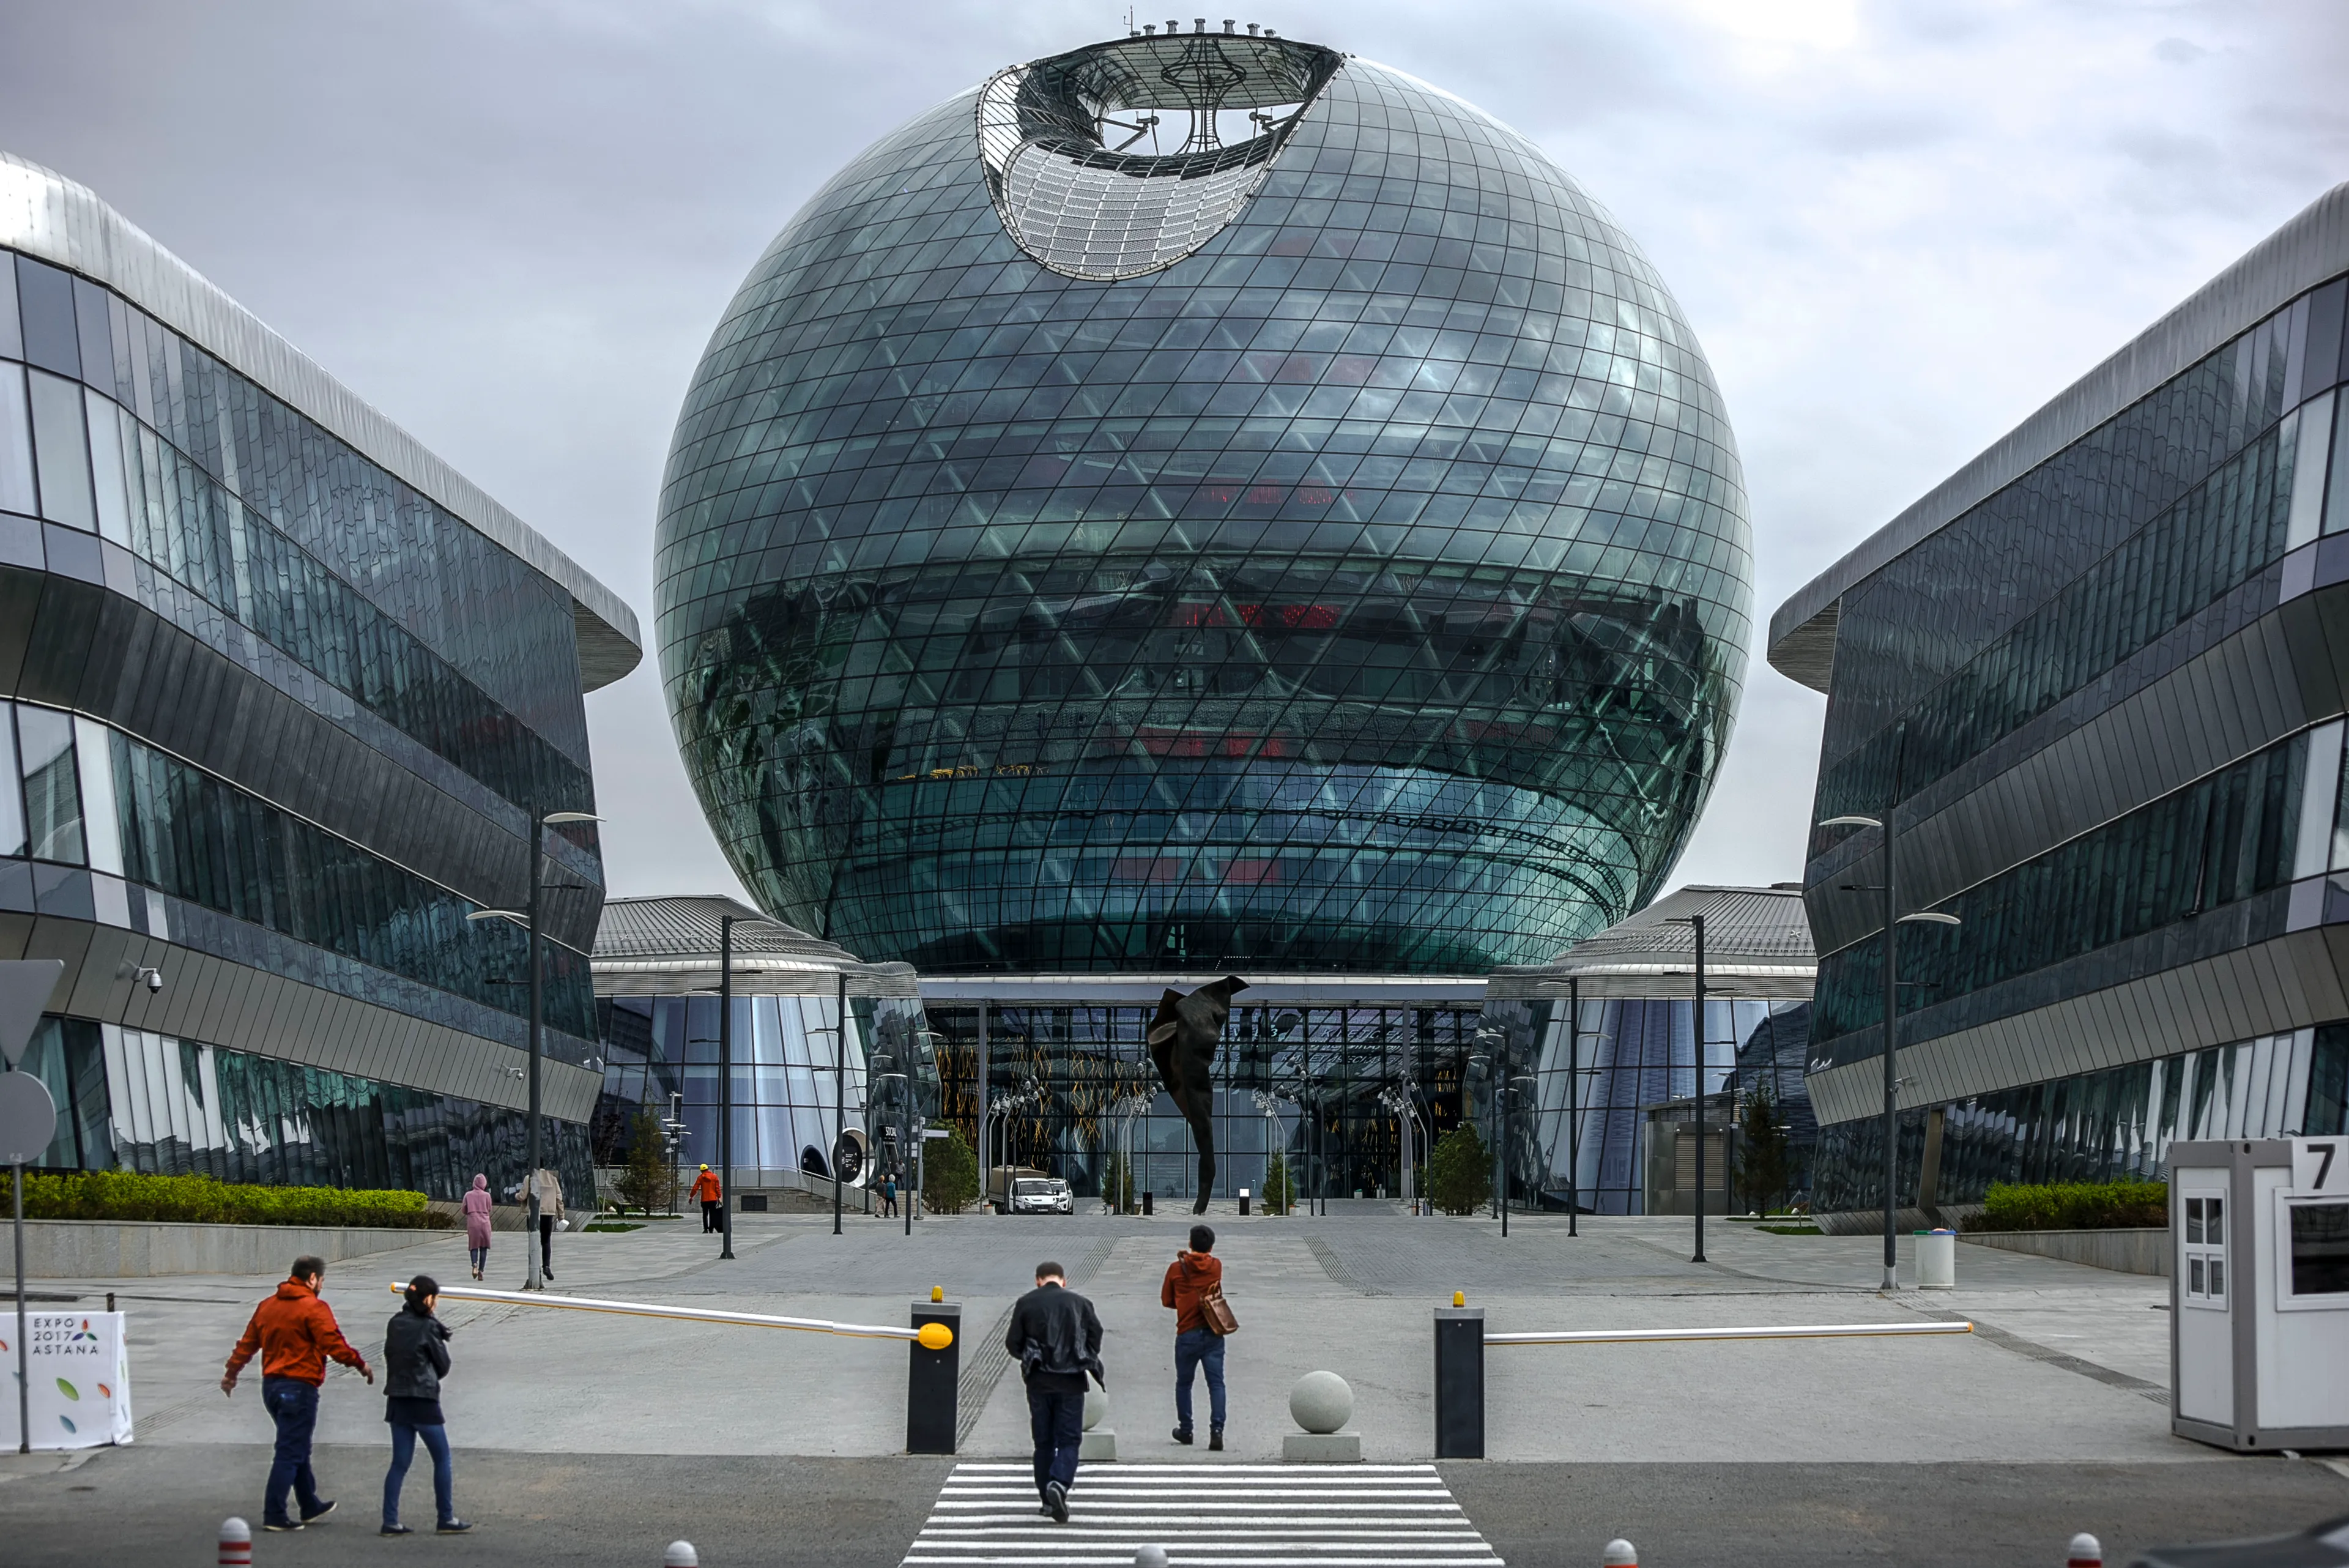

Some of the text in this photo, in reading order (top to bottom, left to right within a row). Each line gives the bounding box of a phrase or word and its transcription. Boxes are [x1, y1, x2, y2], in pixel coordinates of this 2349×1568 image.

[2307, 1143, 2336, 1190] 7
[34, 1318, 74, 1328] EXPO
[34, 1331, 72, 1341] 2017
[33, 1344, 98, 1355] ASTANA
